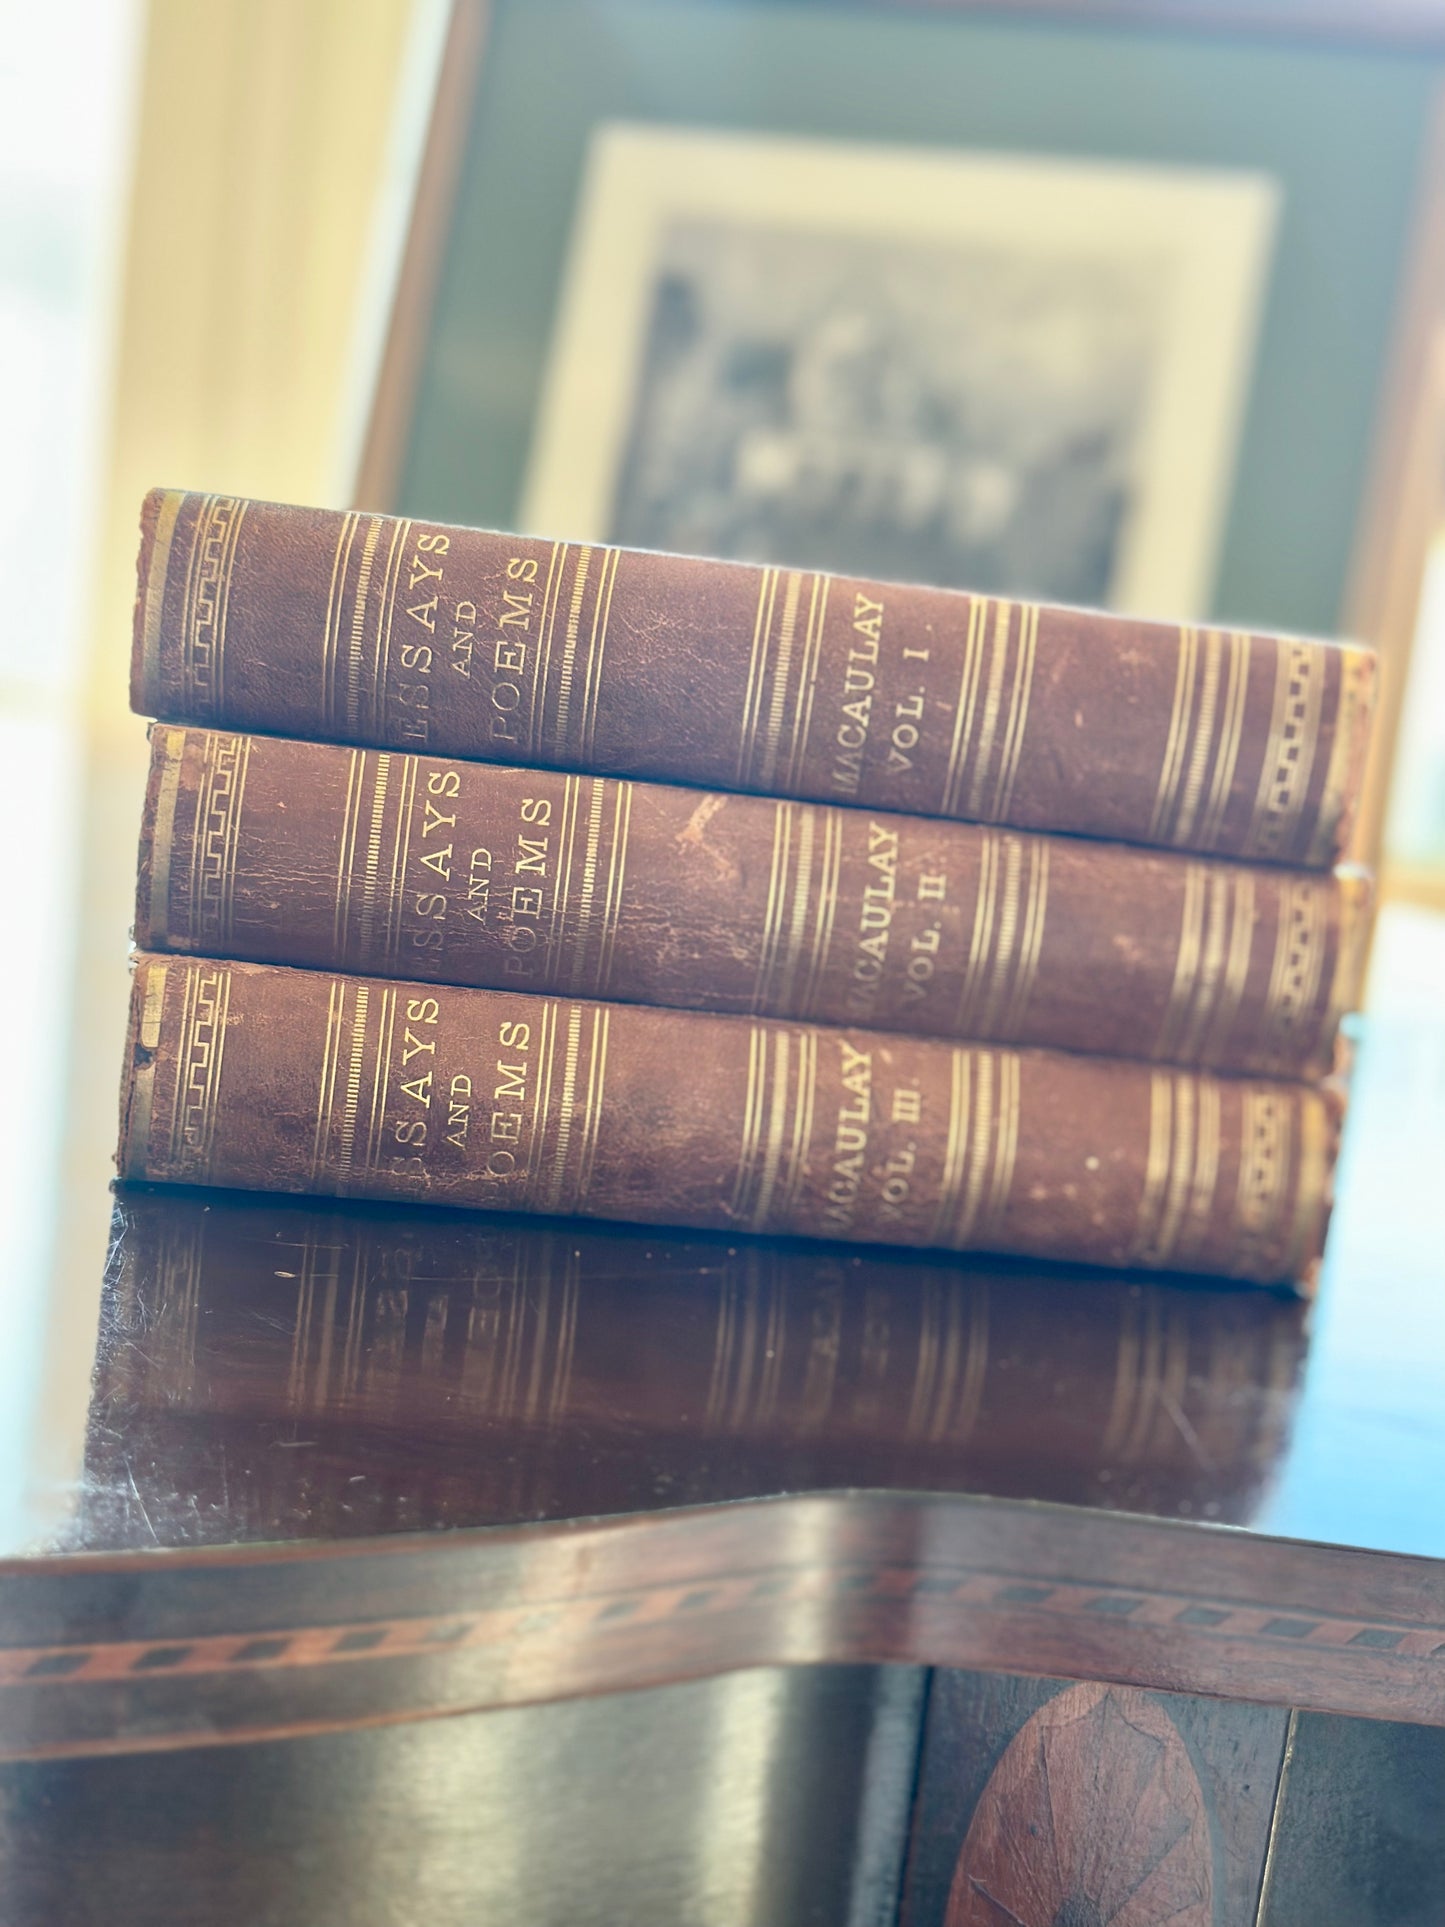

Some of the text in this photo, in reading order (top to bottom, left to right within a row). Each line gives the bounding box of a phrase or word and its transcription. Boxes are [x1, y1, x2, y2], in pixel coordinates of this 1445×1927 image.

[399, 533, 450, 744] ESSAYS
[452, 600, 477, 680] AND
[490, 557, 539, 745] POEMS
[831, 591, 884, 795] MACAULAY
[887, 685, 926, 775] VOL.
[466, 847, 493, 926] AND
[391, 997, 440, 1192] SSAYS
[446, 1073, 473, 1151] AND
[820, 1038, 873, 1233] ACAULAY
